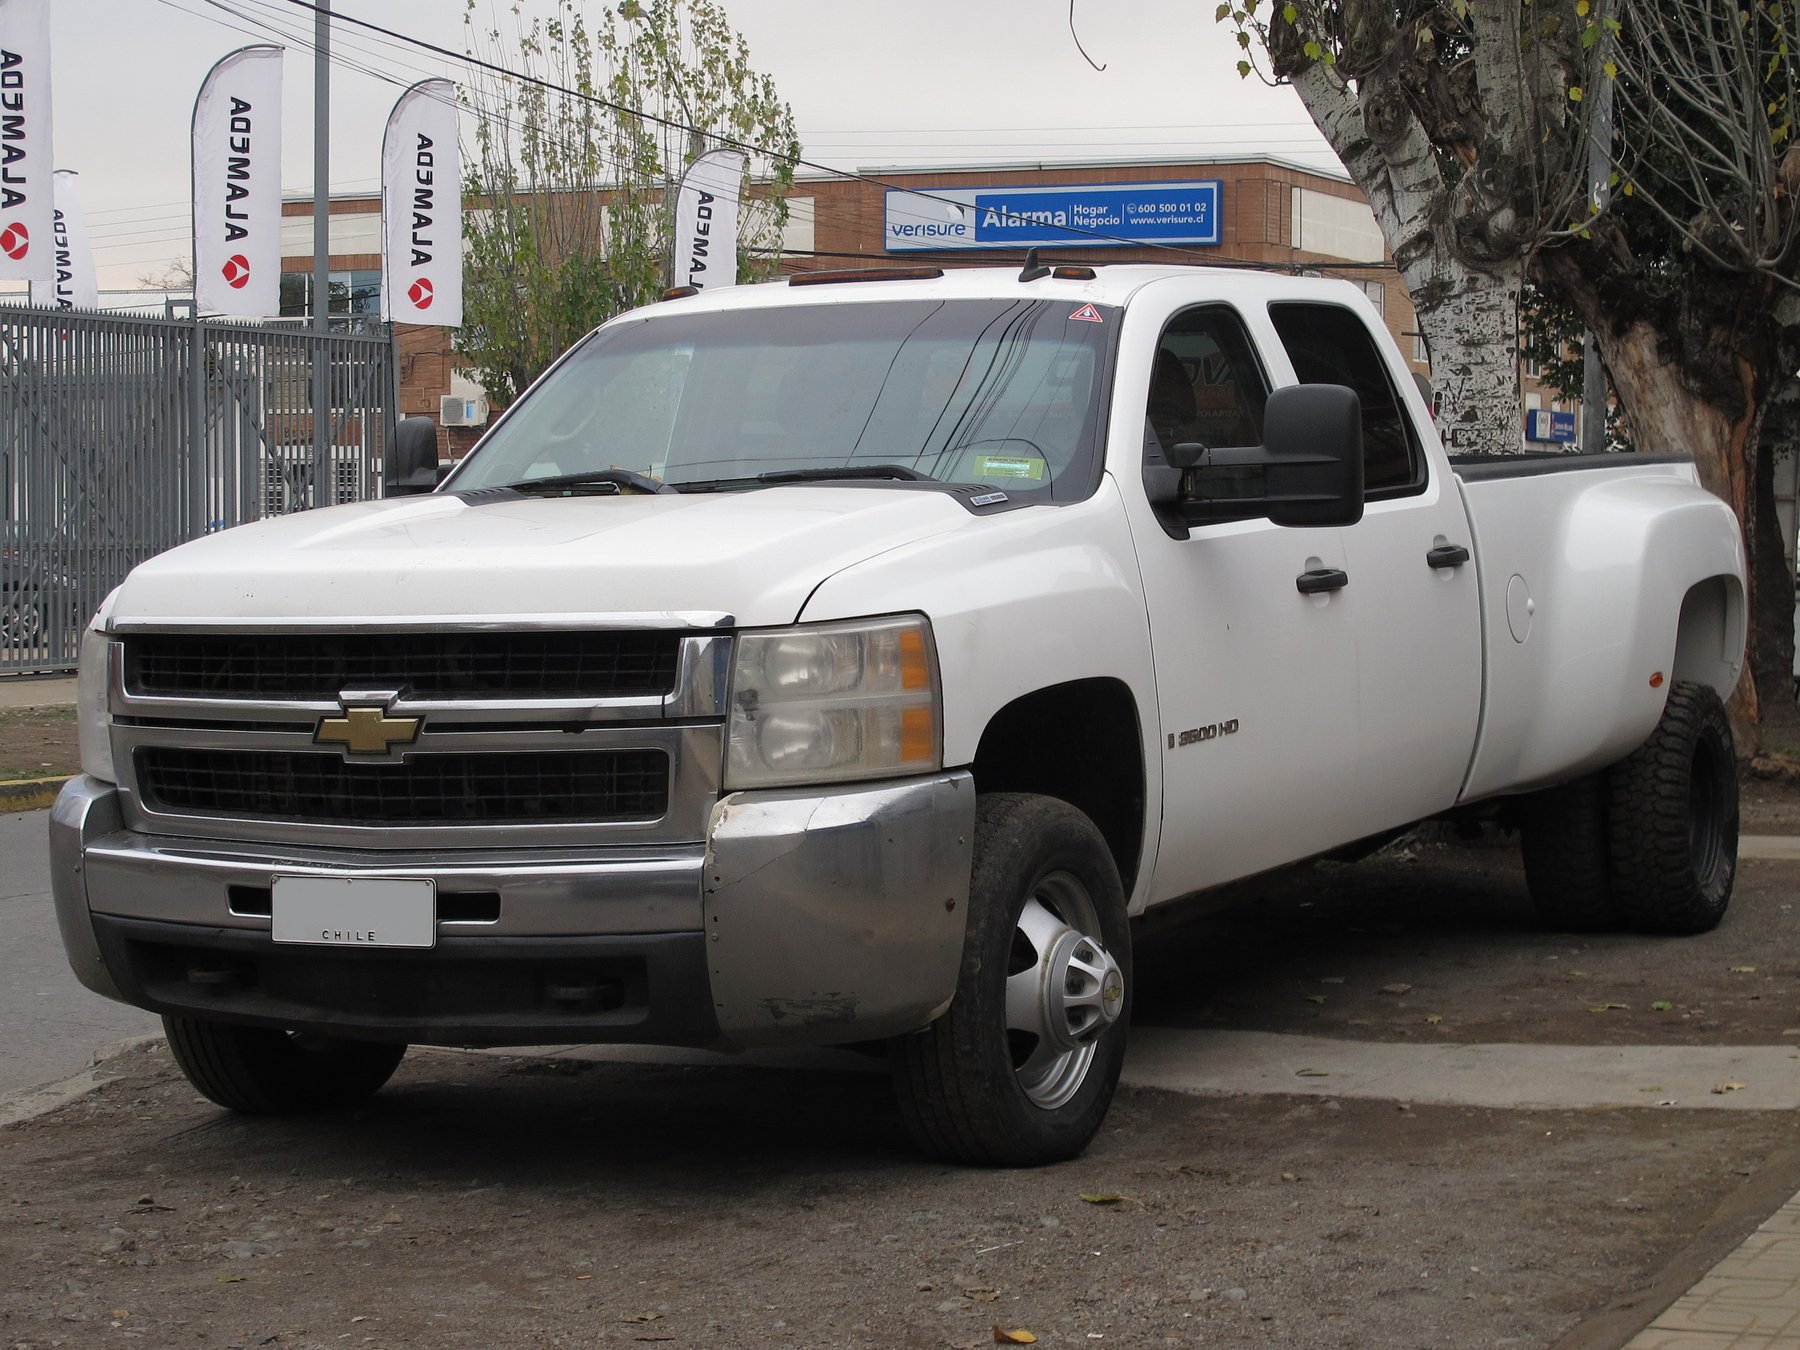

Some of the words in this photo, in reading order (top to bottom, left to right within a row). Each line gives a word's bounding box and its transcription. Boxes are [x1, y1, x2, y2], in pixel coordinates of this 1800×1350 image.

[1073, 204, 1108, 217] Hogar
[1137, 204, 1156, 213] 600
[1159, 203, 1177, 212] 500
[1179, 203, 1191, 212] 01
[1194, 202, 1207, 212] 02
[982, 205, 1067, 228] Alarma
[1073, 215, 1120, 228] Negocio
[1130, 214, 1204, 225] www.verisure.cl
[892, 223, 966, 236] verisure
[1218, 718, 1239, 738] HD
[322, 930, 376, 941] CHILE
